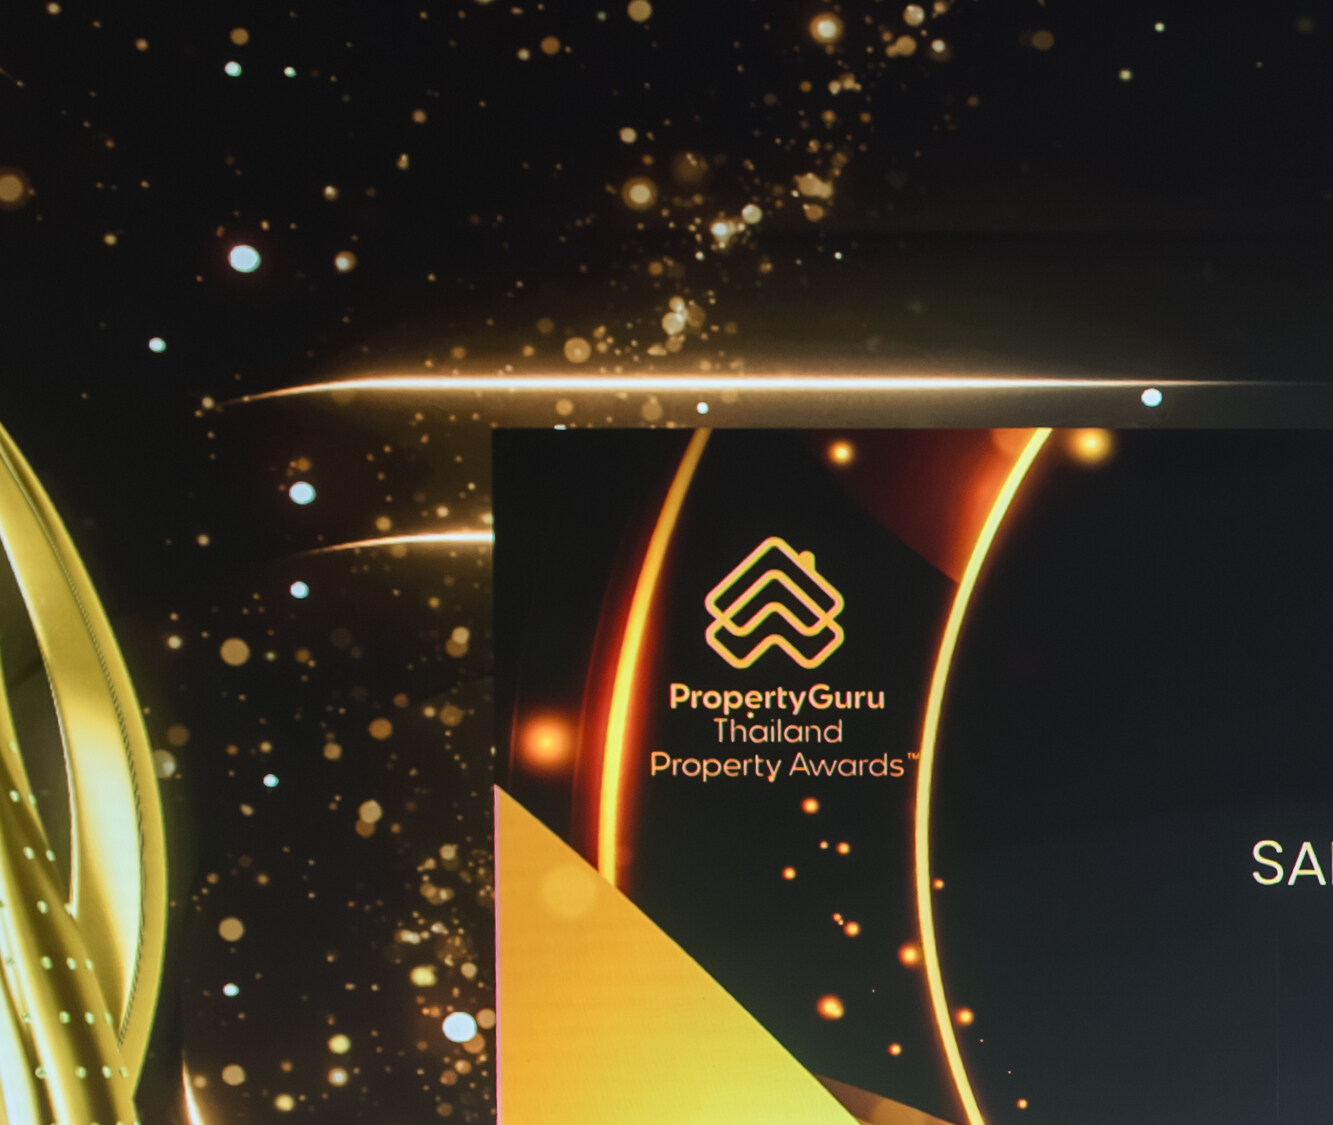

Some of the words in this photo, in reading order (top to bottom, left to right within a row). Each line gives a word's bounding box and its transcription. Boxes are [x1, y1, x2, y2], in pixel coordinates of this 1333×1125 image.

[669, 683, 885, 715] PropertyGuru
[713, 718, 843, 743] Thailand
[650, 751, 781, 782] Property
